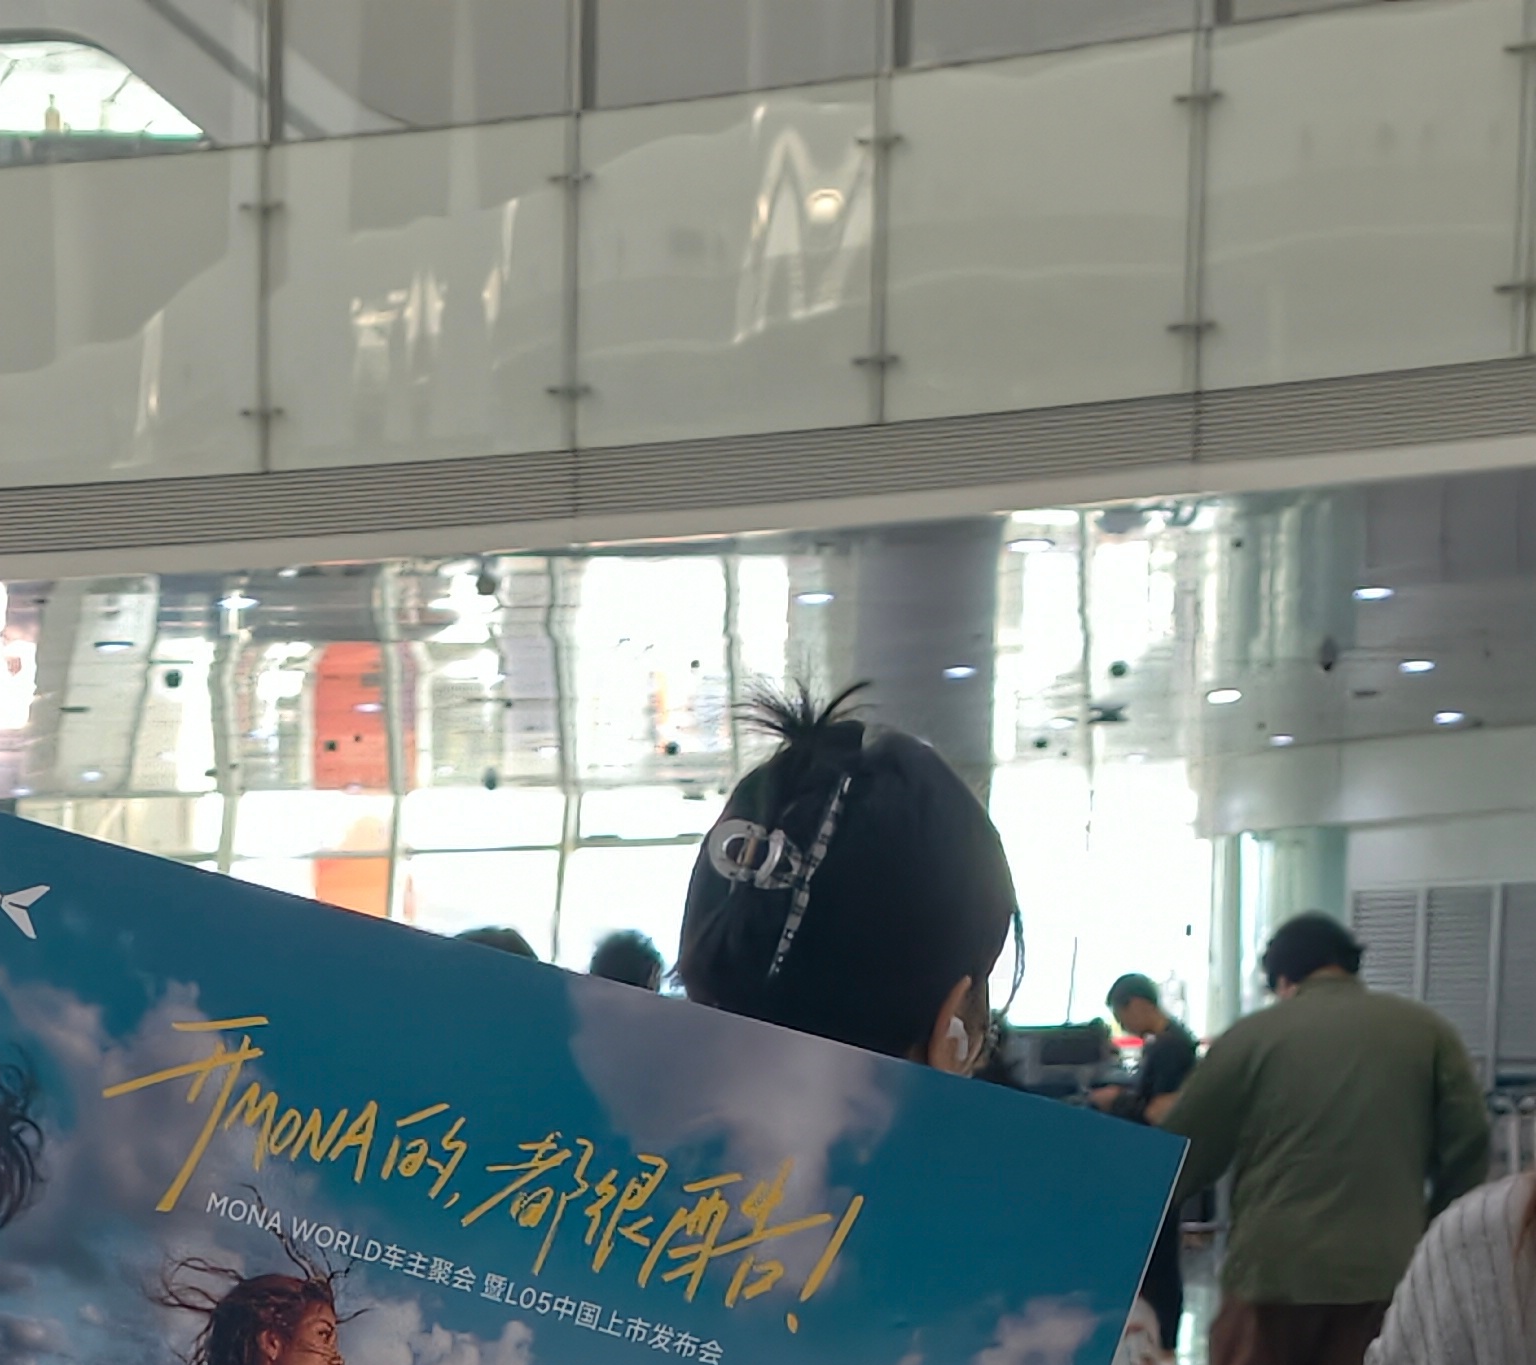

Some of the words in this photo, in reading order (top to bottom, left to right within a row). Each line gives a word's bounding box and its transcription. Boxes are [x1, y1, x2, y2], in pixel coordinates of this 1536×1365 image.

[205, 1191, 283, 1235] MONA
[291, 1216, 478, 1293] WORLD车主聚会
